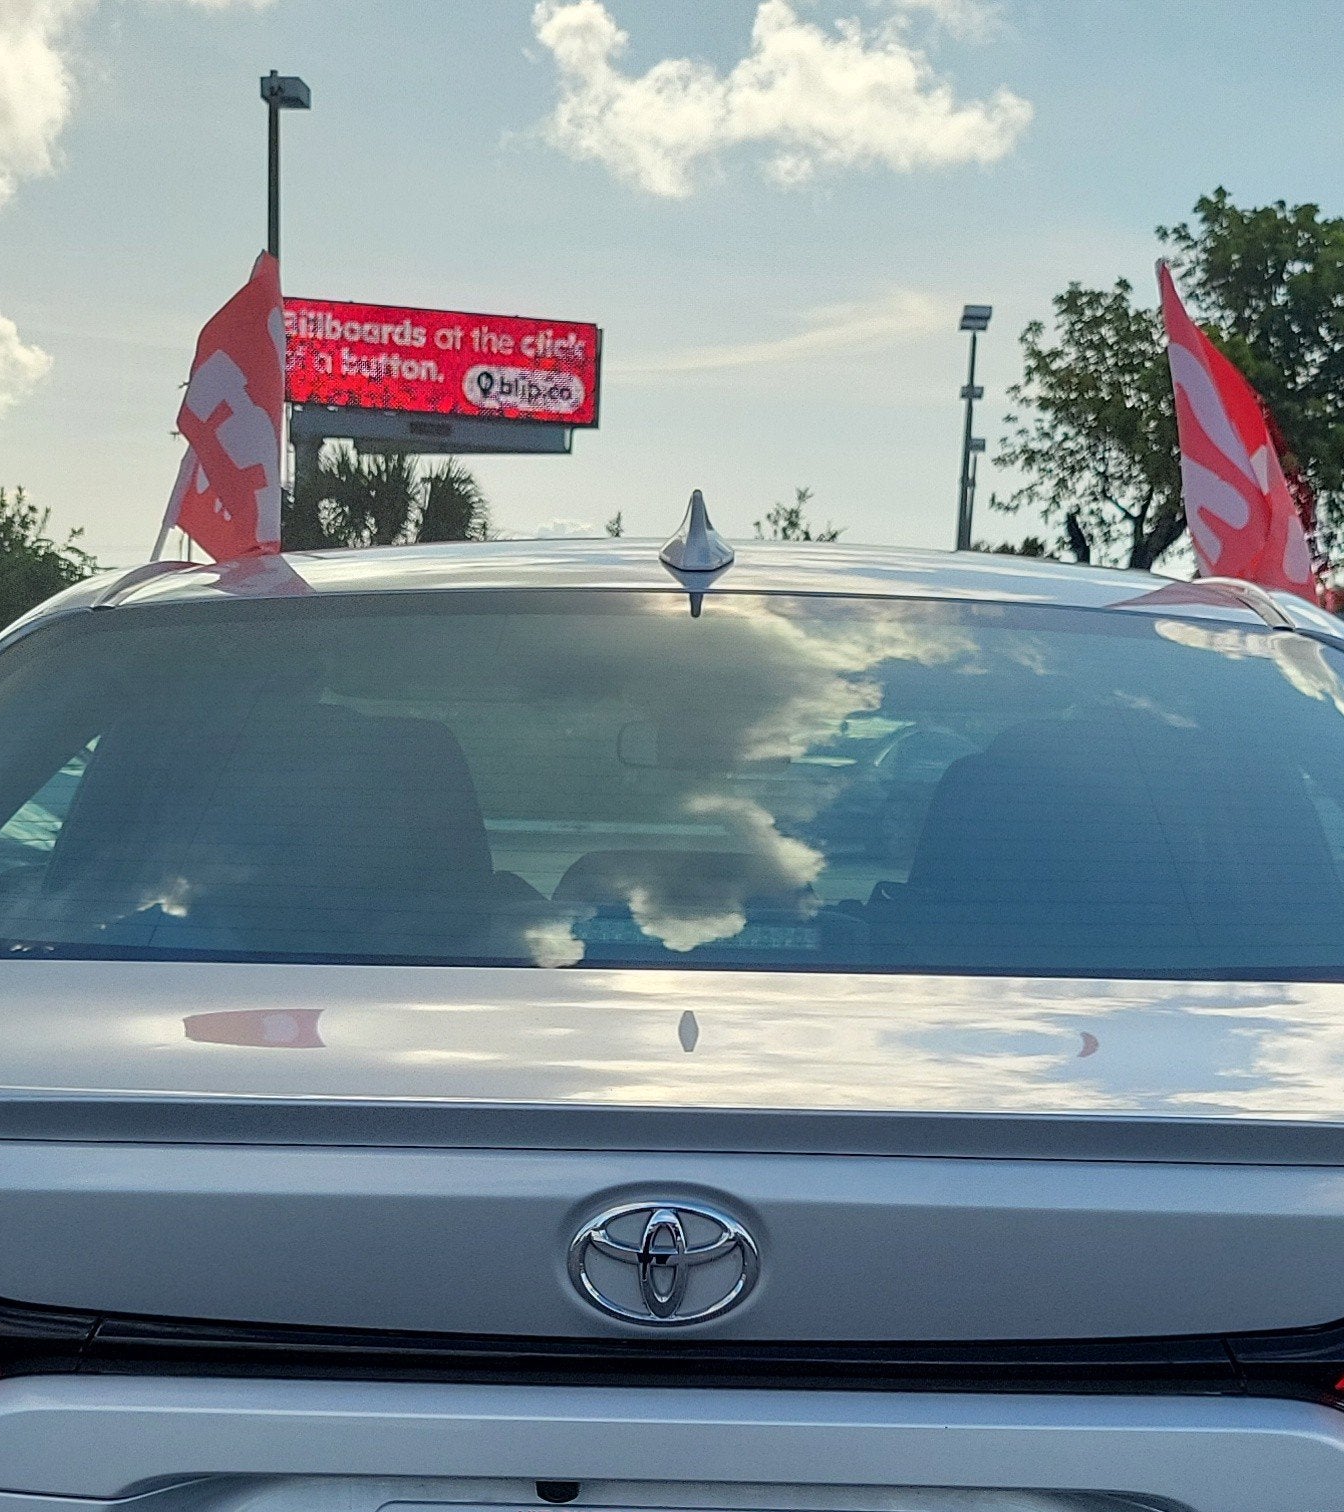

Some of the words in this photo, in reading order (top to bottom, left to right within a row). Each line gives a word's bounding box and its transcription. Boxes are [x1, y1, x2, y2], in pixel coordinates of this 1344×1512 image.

[433, 325, 464, 351] at
[470, 325, 516, 356] the
[520, 329, 586, 359] click
[314, 352, 333, 375] a
